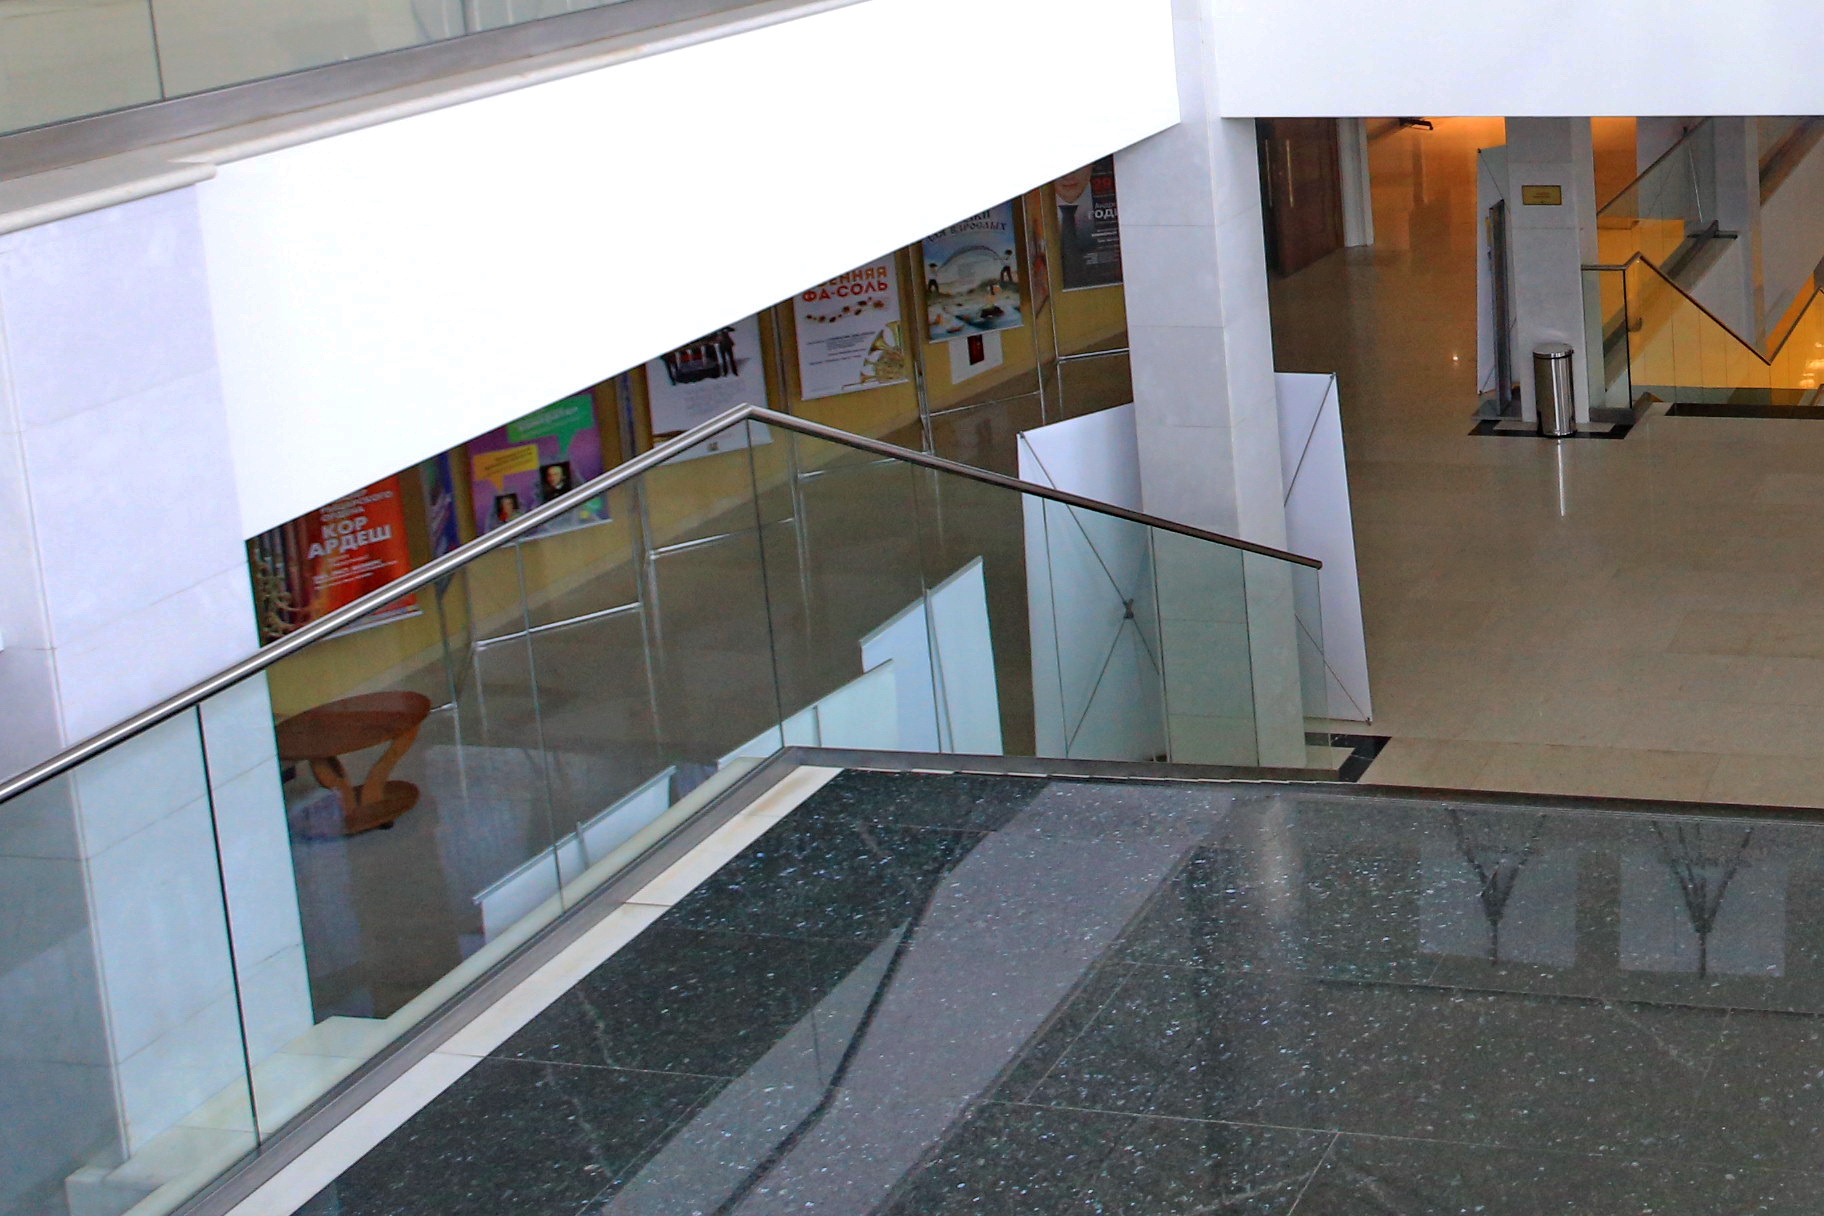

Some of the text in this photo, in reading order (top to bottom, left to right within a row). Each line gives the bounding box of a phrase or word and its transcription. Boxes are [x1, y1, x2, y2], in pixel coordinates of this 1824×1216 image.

[802, 279, 889, 302] ФА-СОЛЬ
[321, 516, 368, 539] КОР
[307, 525, 393, 559] АРДЕШ
